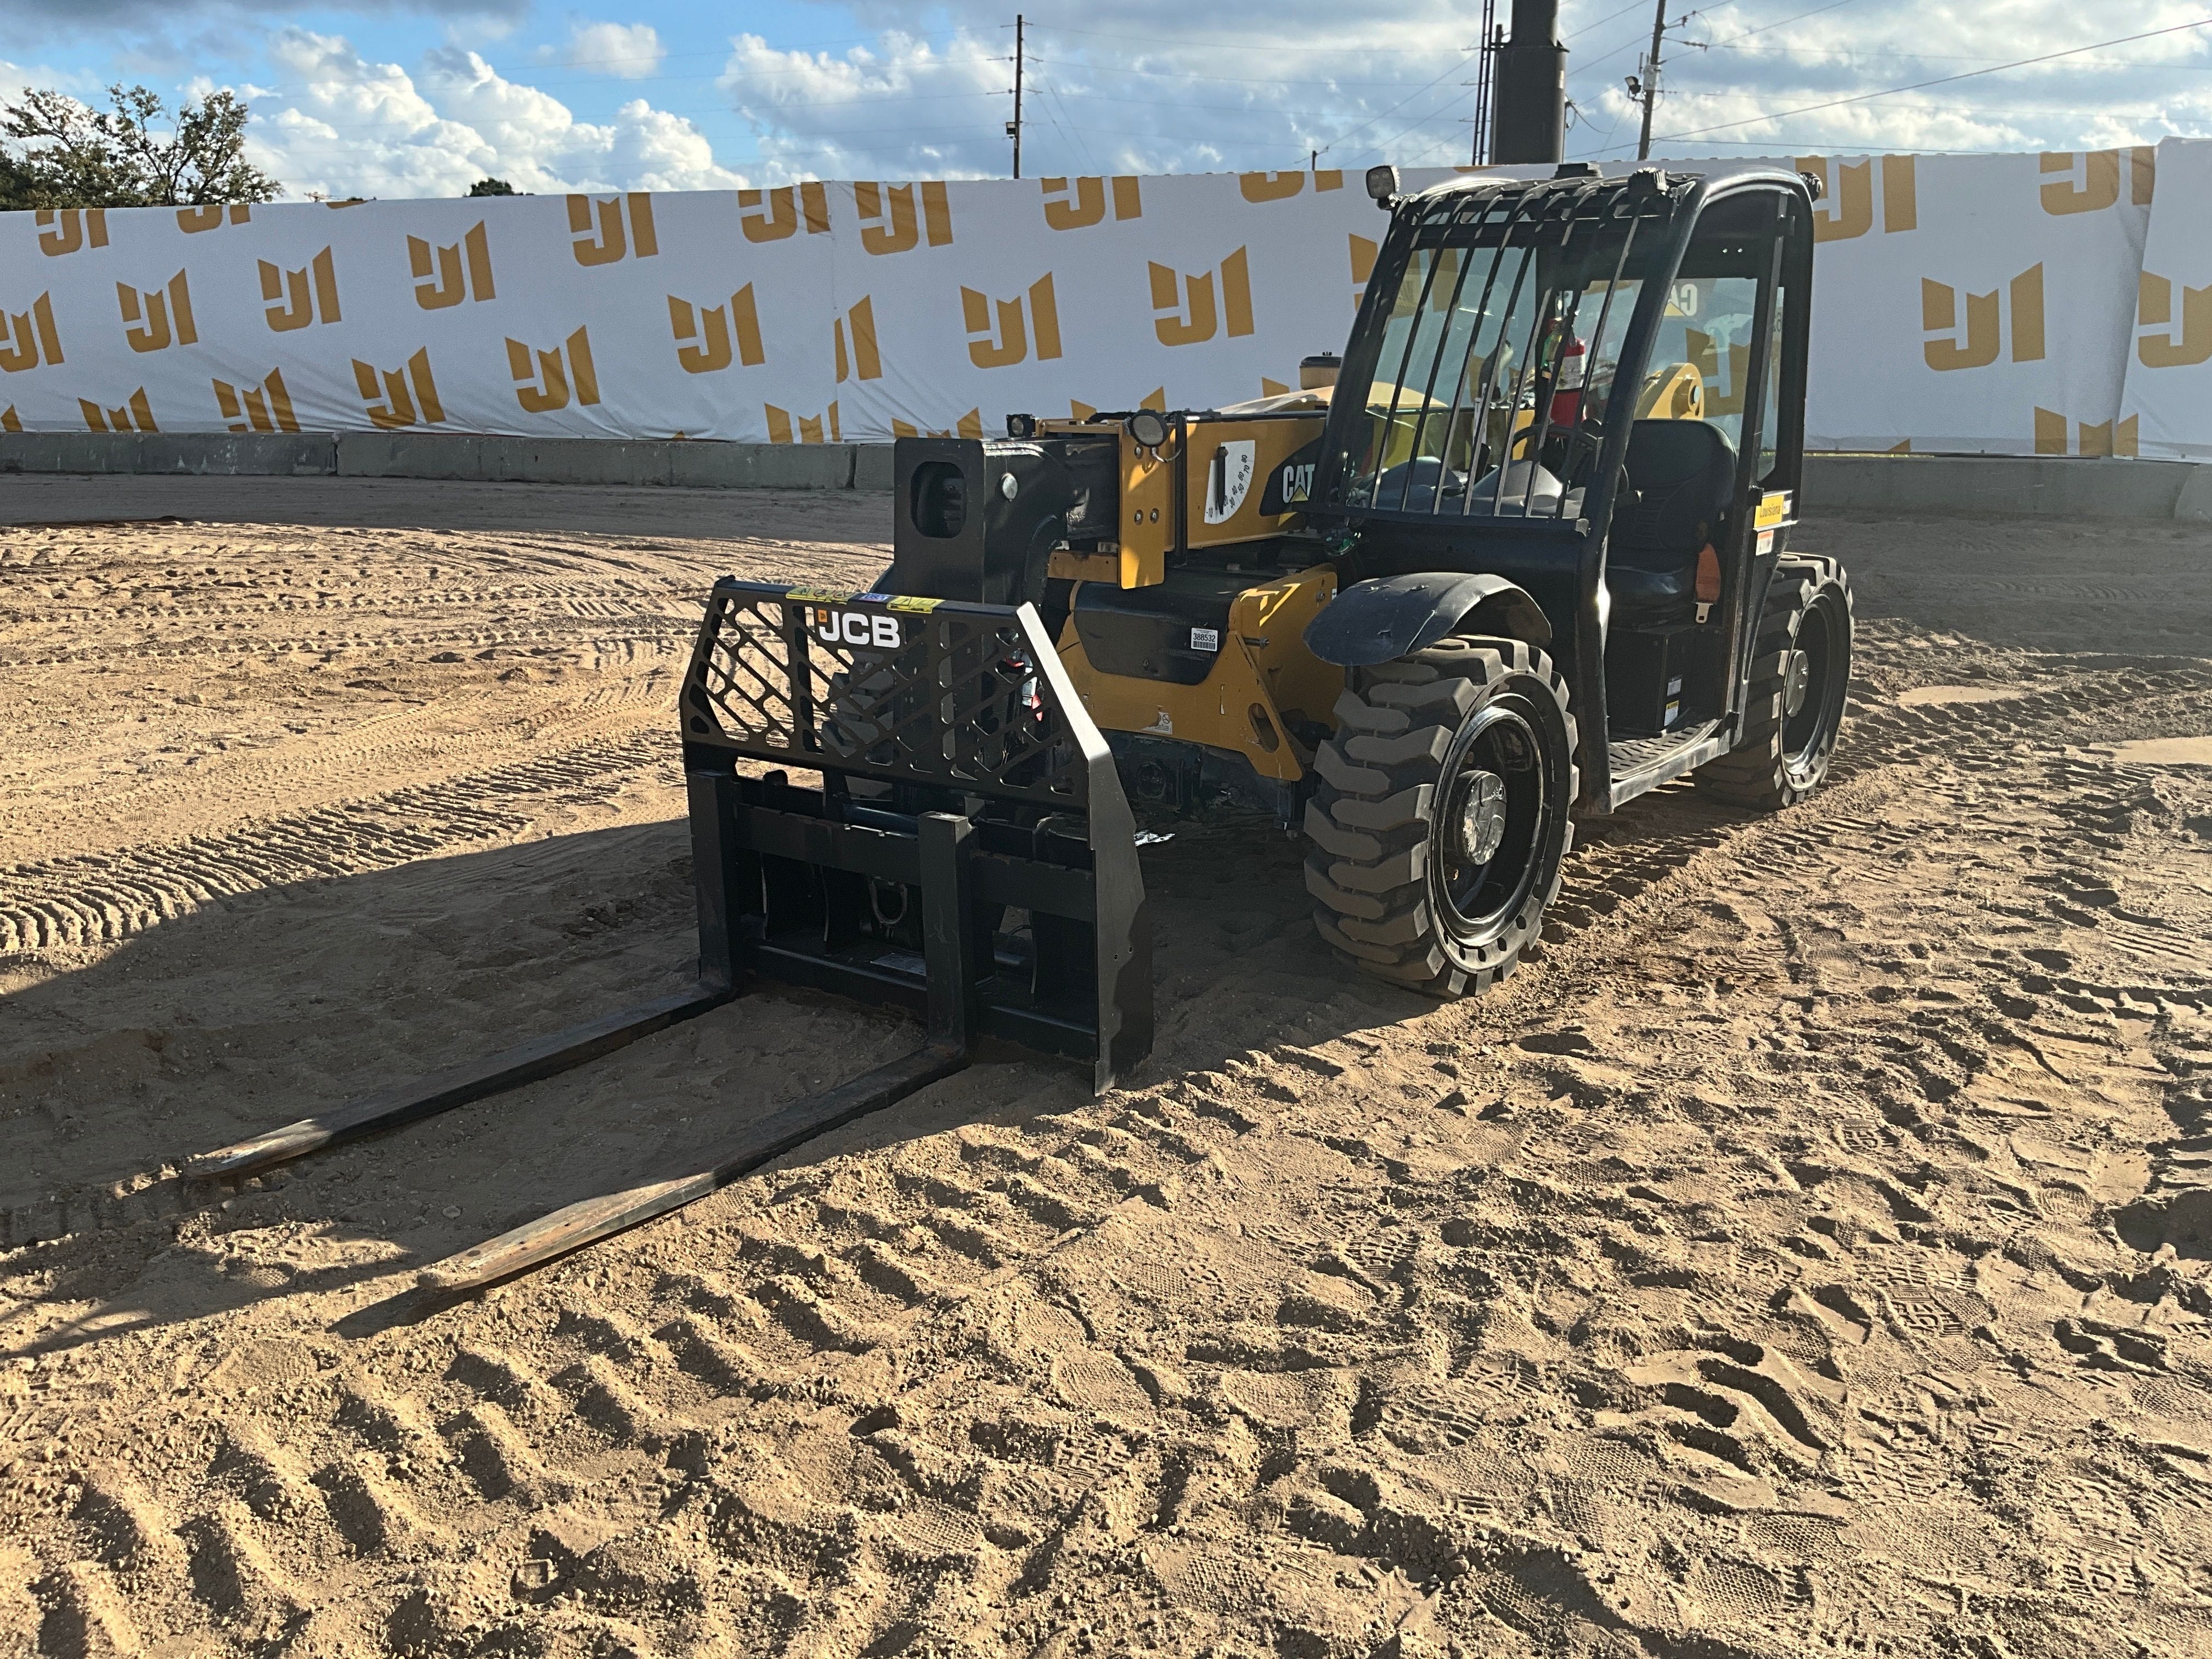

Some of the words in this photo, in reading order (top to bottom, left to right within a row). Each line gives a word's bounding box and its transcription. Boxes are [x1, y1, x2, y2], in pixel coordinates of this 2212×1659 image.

[1242, 455, 1248, 463] 80
[1244, 465, 1250, 474] 70
[1238, 471, 1245, 481] 60
[1283, 464, 1316, 503] CAT
[819, 611, 901, 648] JCB
[1193, 633, 1216, 642] 388532
